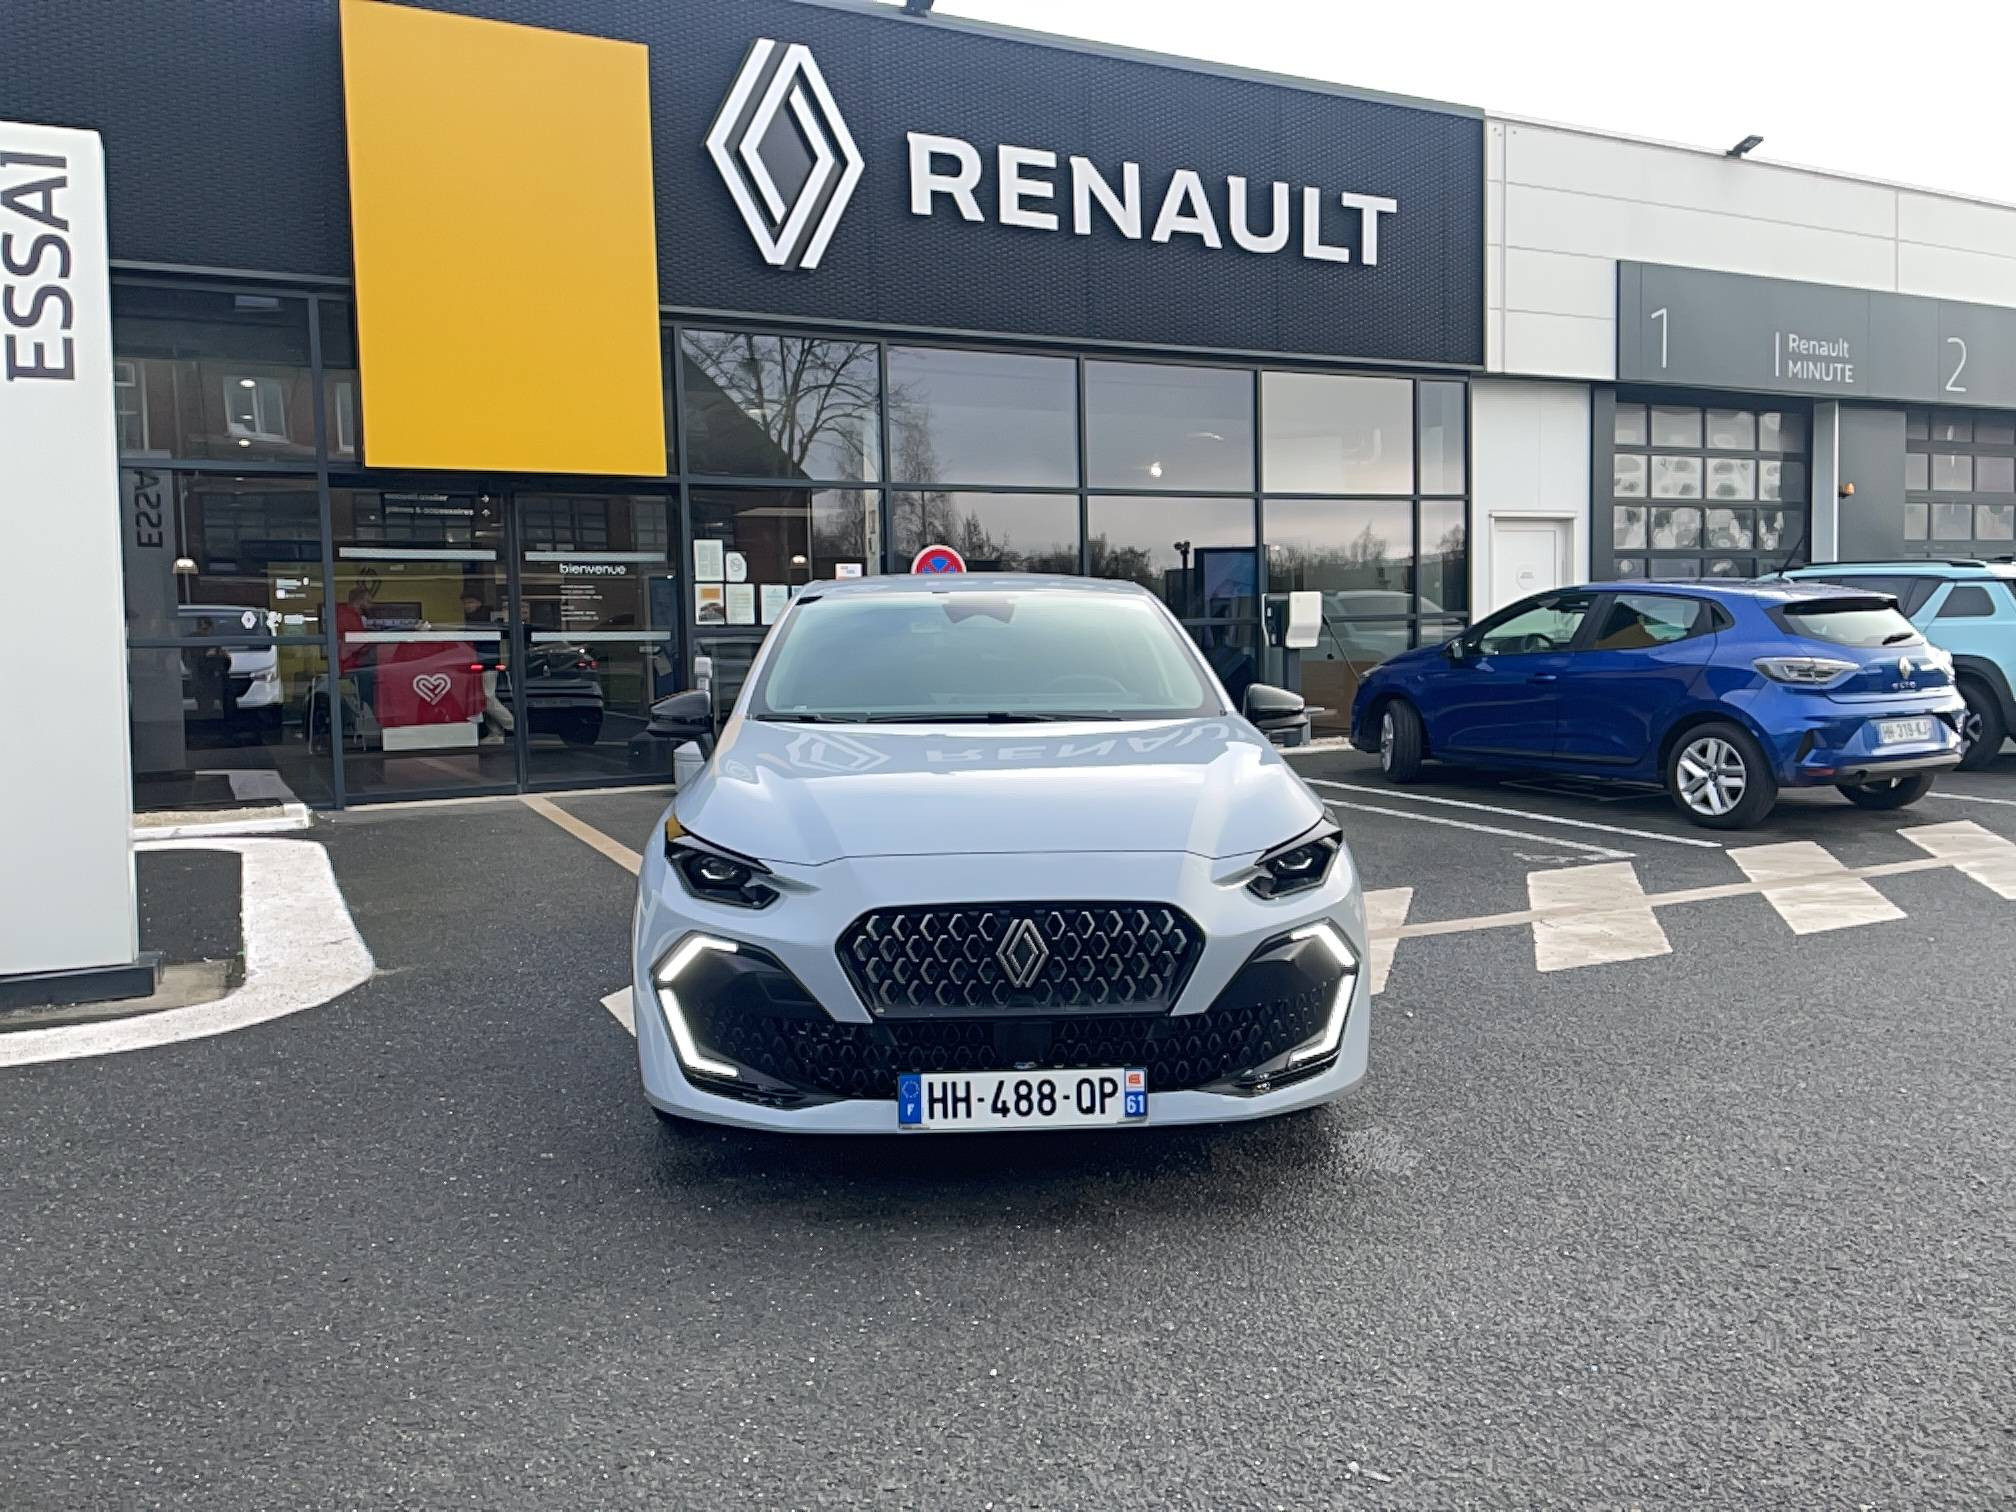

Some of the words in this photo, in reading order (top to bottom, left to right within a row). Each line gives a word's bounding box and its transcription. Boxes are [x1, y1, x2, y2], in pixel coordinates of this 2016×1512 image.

[907, 131, 1397, 266] RENAULT
[0, 150, 75, 381] ESSAI
[1651, 307, 1668, 368] 1
[1788, 333, 1849, 358] Renault
[1788, 360, 1854, 383] MINUTE
[1945, 337, 1967, 392] 2
[559, 563, 626, 575] bienvenue
[907, 1103, 915, 1117] F
[928, 1077, 1118, 1119] HH-488-QP
[1126, 1094, 1145, 1114] 61
